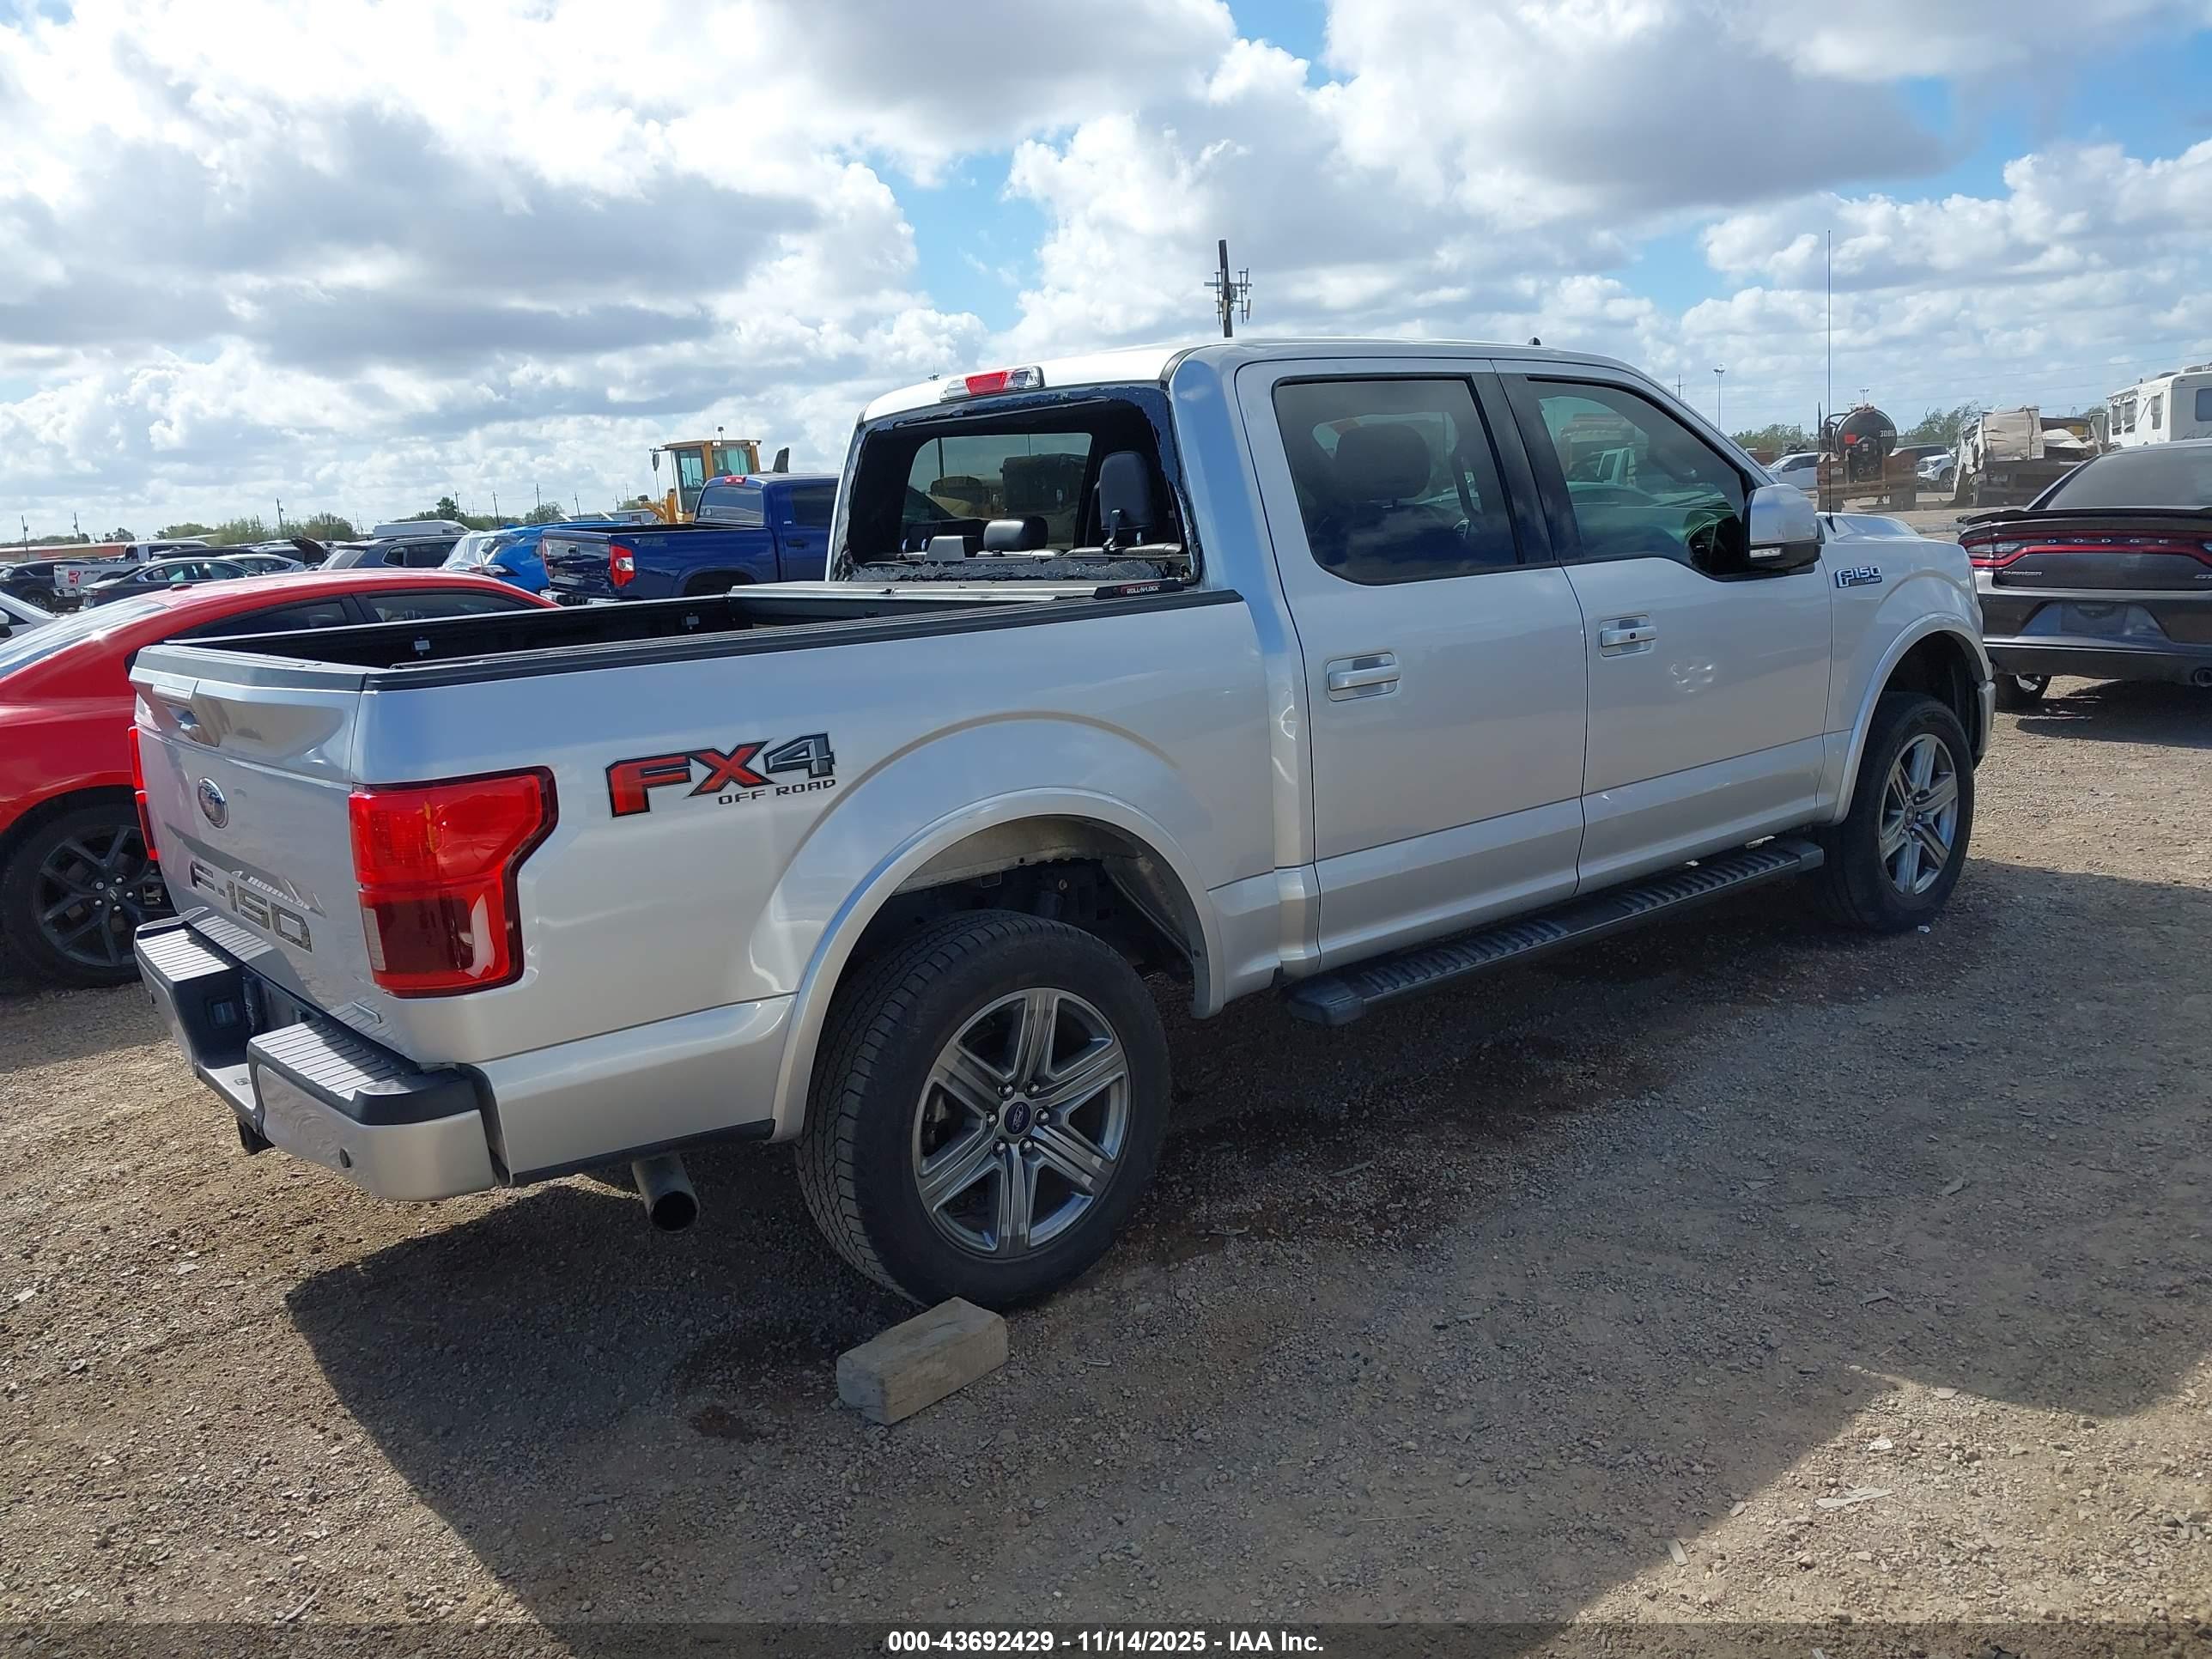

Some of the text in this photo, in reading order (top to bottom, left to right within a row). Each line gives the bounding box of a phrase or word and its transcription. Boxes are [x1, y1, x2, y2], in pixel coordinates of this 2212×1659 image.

[606, 732, 836, 817] FX4
[718, 778, 837, 805] OFF ROAD
[189, 860, 313, 954] F-150
